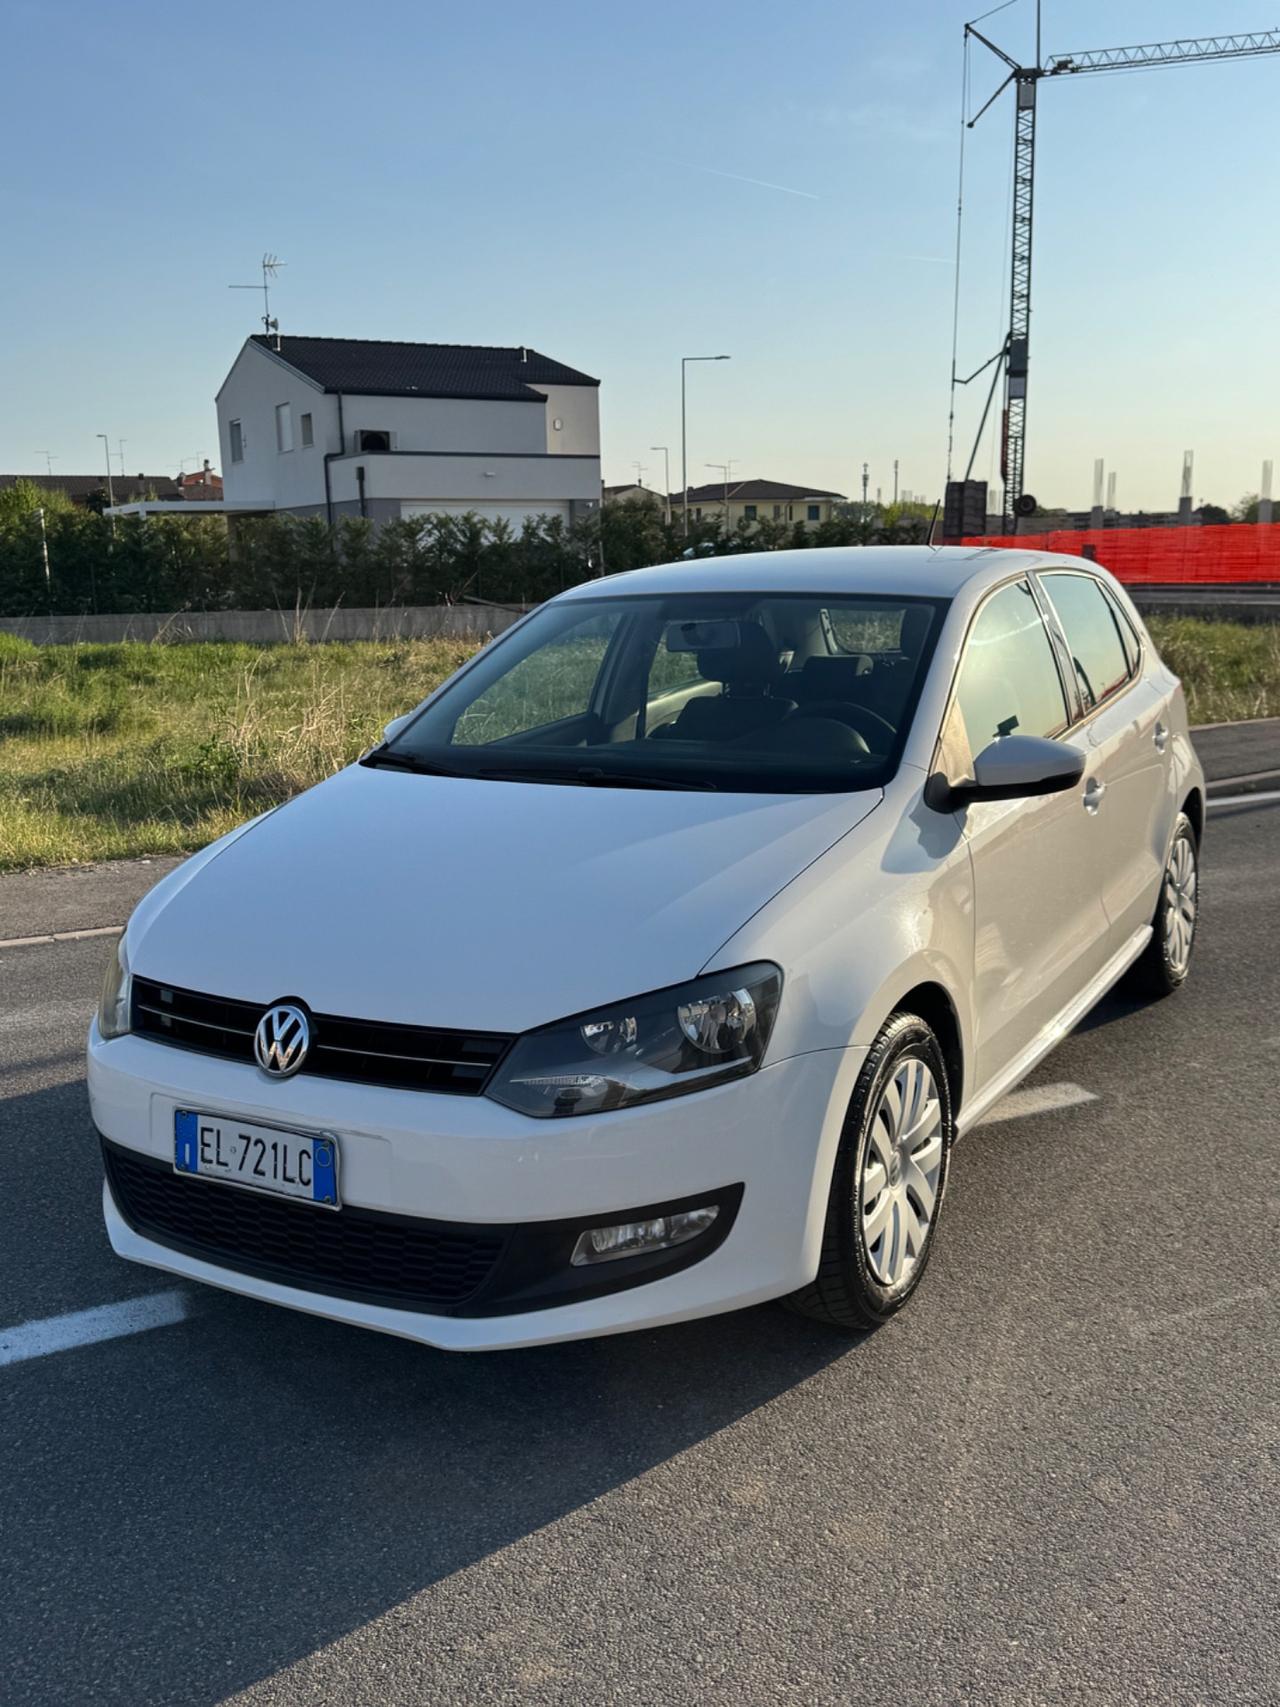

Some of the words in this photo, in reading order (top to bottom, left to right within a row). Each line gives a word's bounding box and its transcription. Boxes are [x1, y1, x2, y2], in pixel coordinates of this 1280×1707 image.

[255, 1006, 308, 1076] VW
[200, 1126, 229, 1167] EL
[238, 1133, 312, 1186] 721LC
